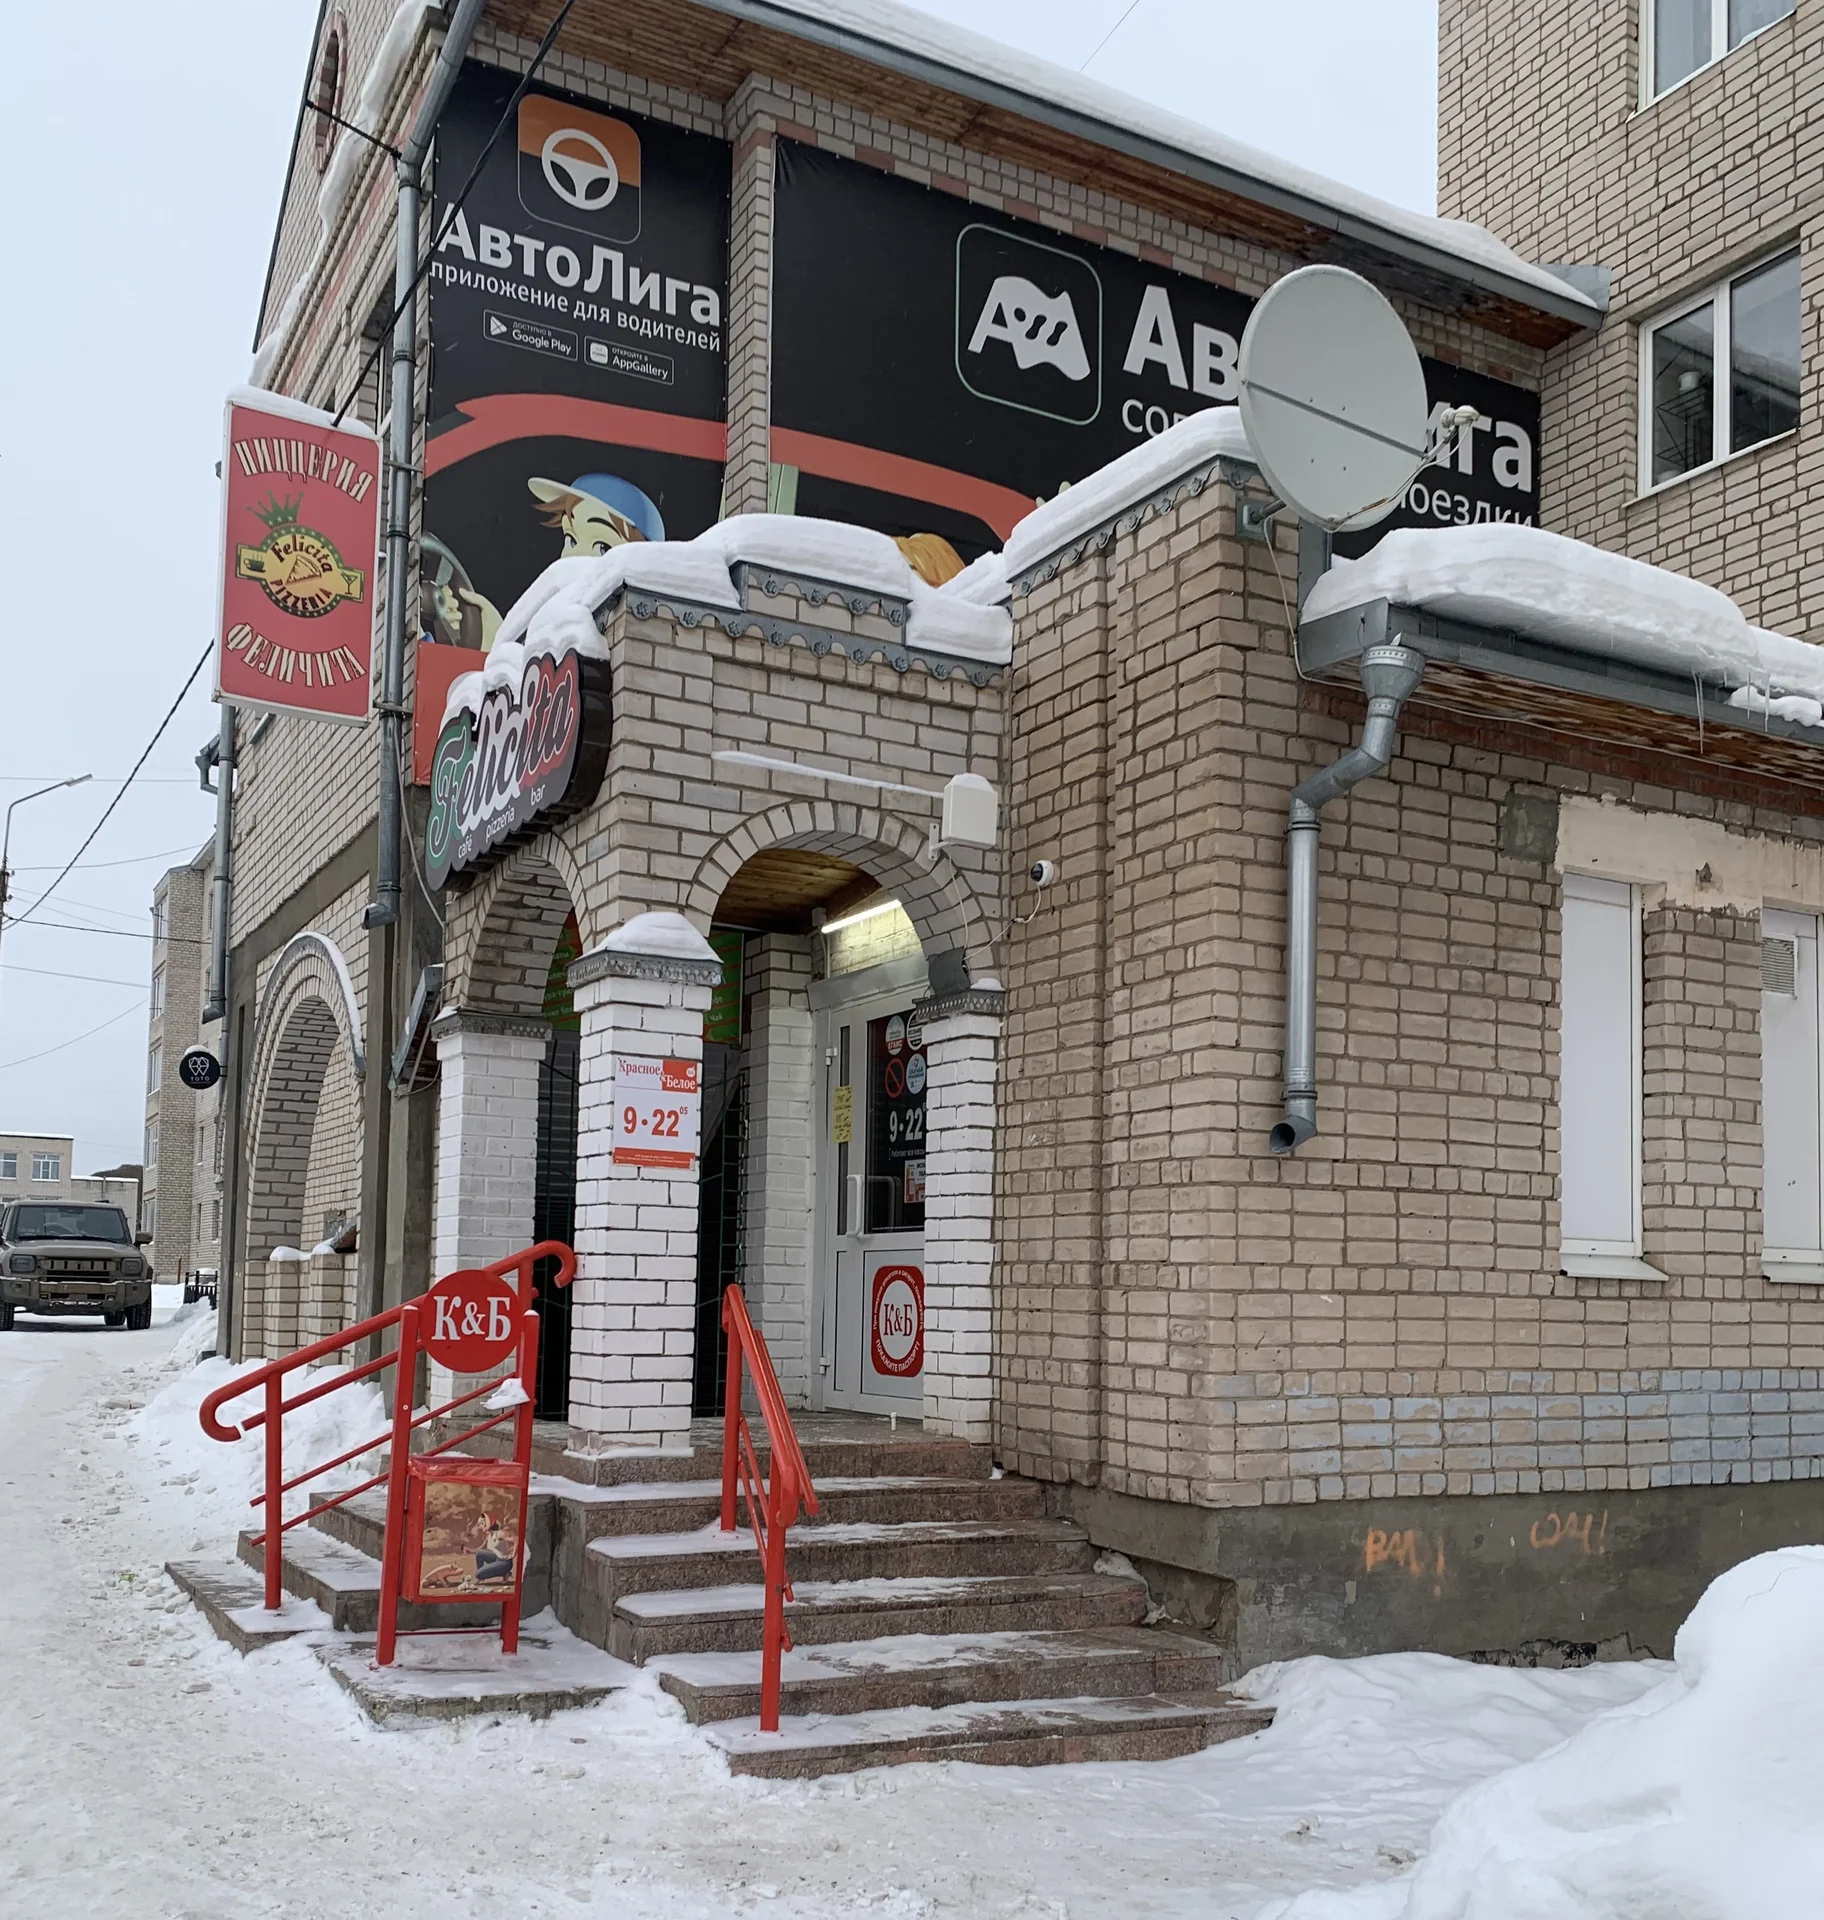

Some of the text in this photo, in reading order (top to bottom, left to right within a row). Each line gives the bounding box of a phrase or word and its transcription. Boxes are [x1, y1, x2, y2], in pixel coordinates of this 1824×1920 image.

[438, 202, 720, 327] АвтоЛига
[430, 260, 720, 352] приложение для водителей
[512, 329, 571, 355] Google Play
[612, 357, 668, 380] AppGallery
[234, 437, 375, 503] ПИЦЦЕРИЯ
[270, 534, 333, 574] Felicita
[270, 578, 333, 611] PIZZERIA
[225, 622, 367, 688] ФЕЛИЧИТА
[485, 806, 515, 842] pizzeria
[530, 784, 546, 806] bar
[618, 1058, 660, 1076] Красное
[666, 1074, 696, 1090] Белое
[431, 1295, 512, 1342] К&Б
[884, 1304, 913, 1337] К&Б
